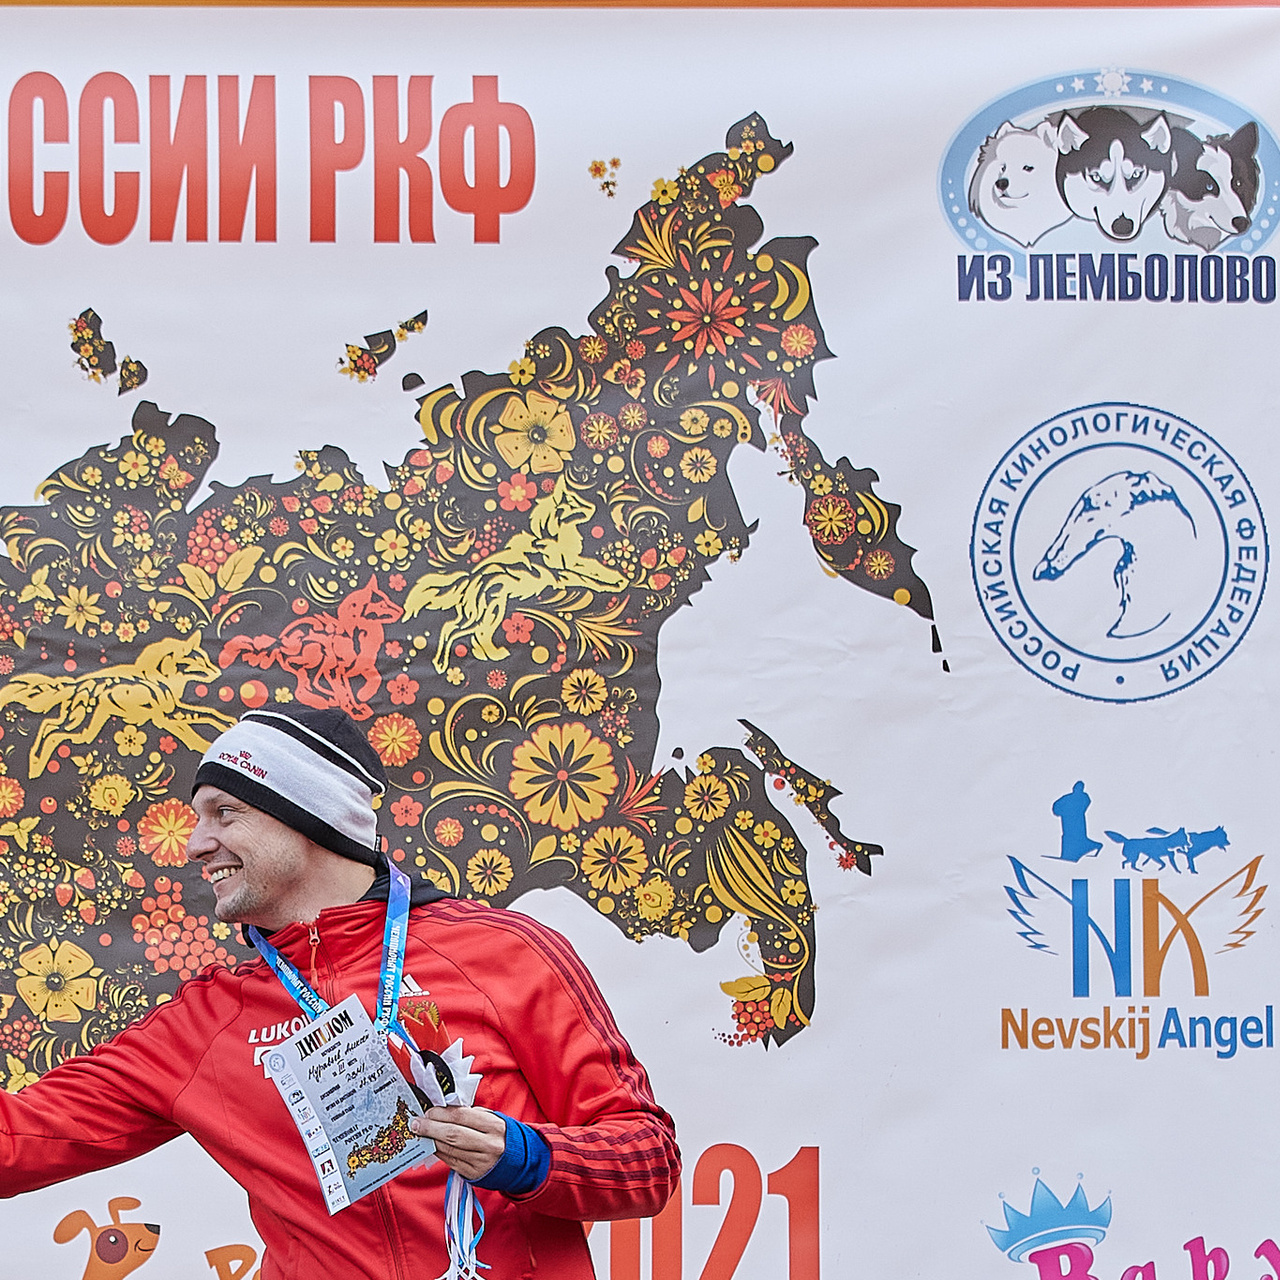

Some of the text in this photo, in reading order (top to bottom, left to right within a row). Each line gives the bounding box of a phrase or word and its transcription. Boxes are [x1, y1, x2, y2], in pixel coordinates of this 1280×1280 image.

[308, 75, 536, 244] РКФ
[957, 253, 1276, 303] ИЗ ЛЕМБОЛОВО
[981, 412, 1258, 683] РОССИЙСКАЯ КИНОЛОГИЧЕСКАЯ ФЕДЕРАЦИЯ
[295, 1009, 354, 1062] ДИПЛОМ
[1001, 1005, 1274, 1060] Nevskij Angel
